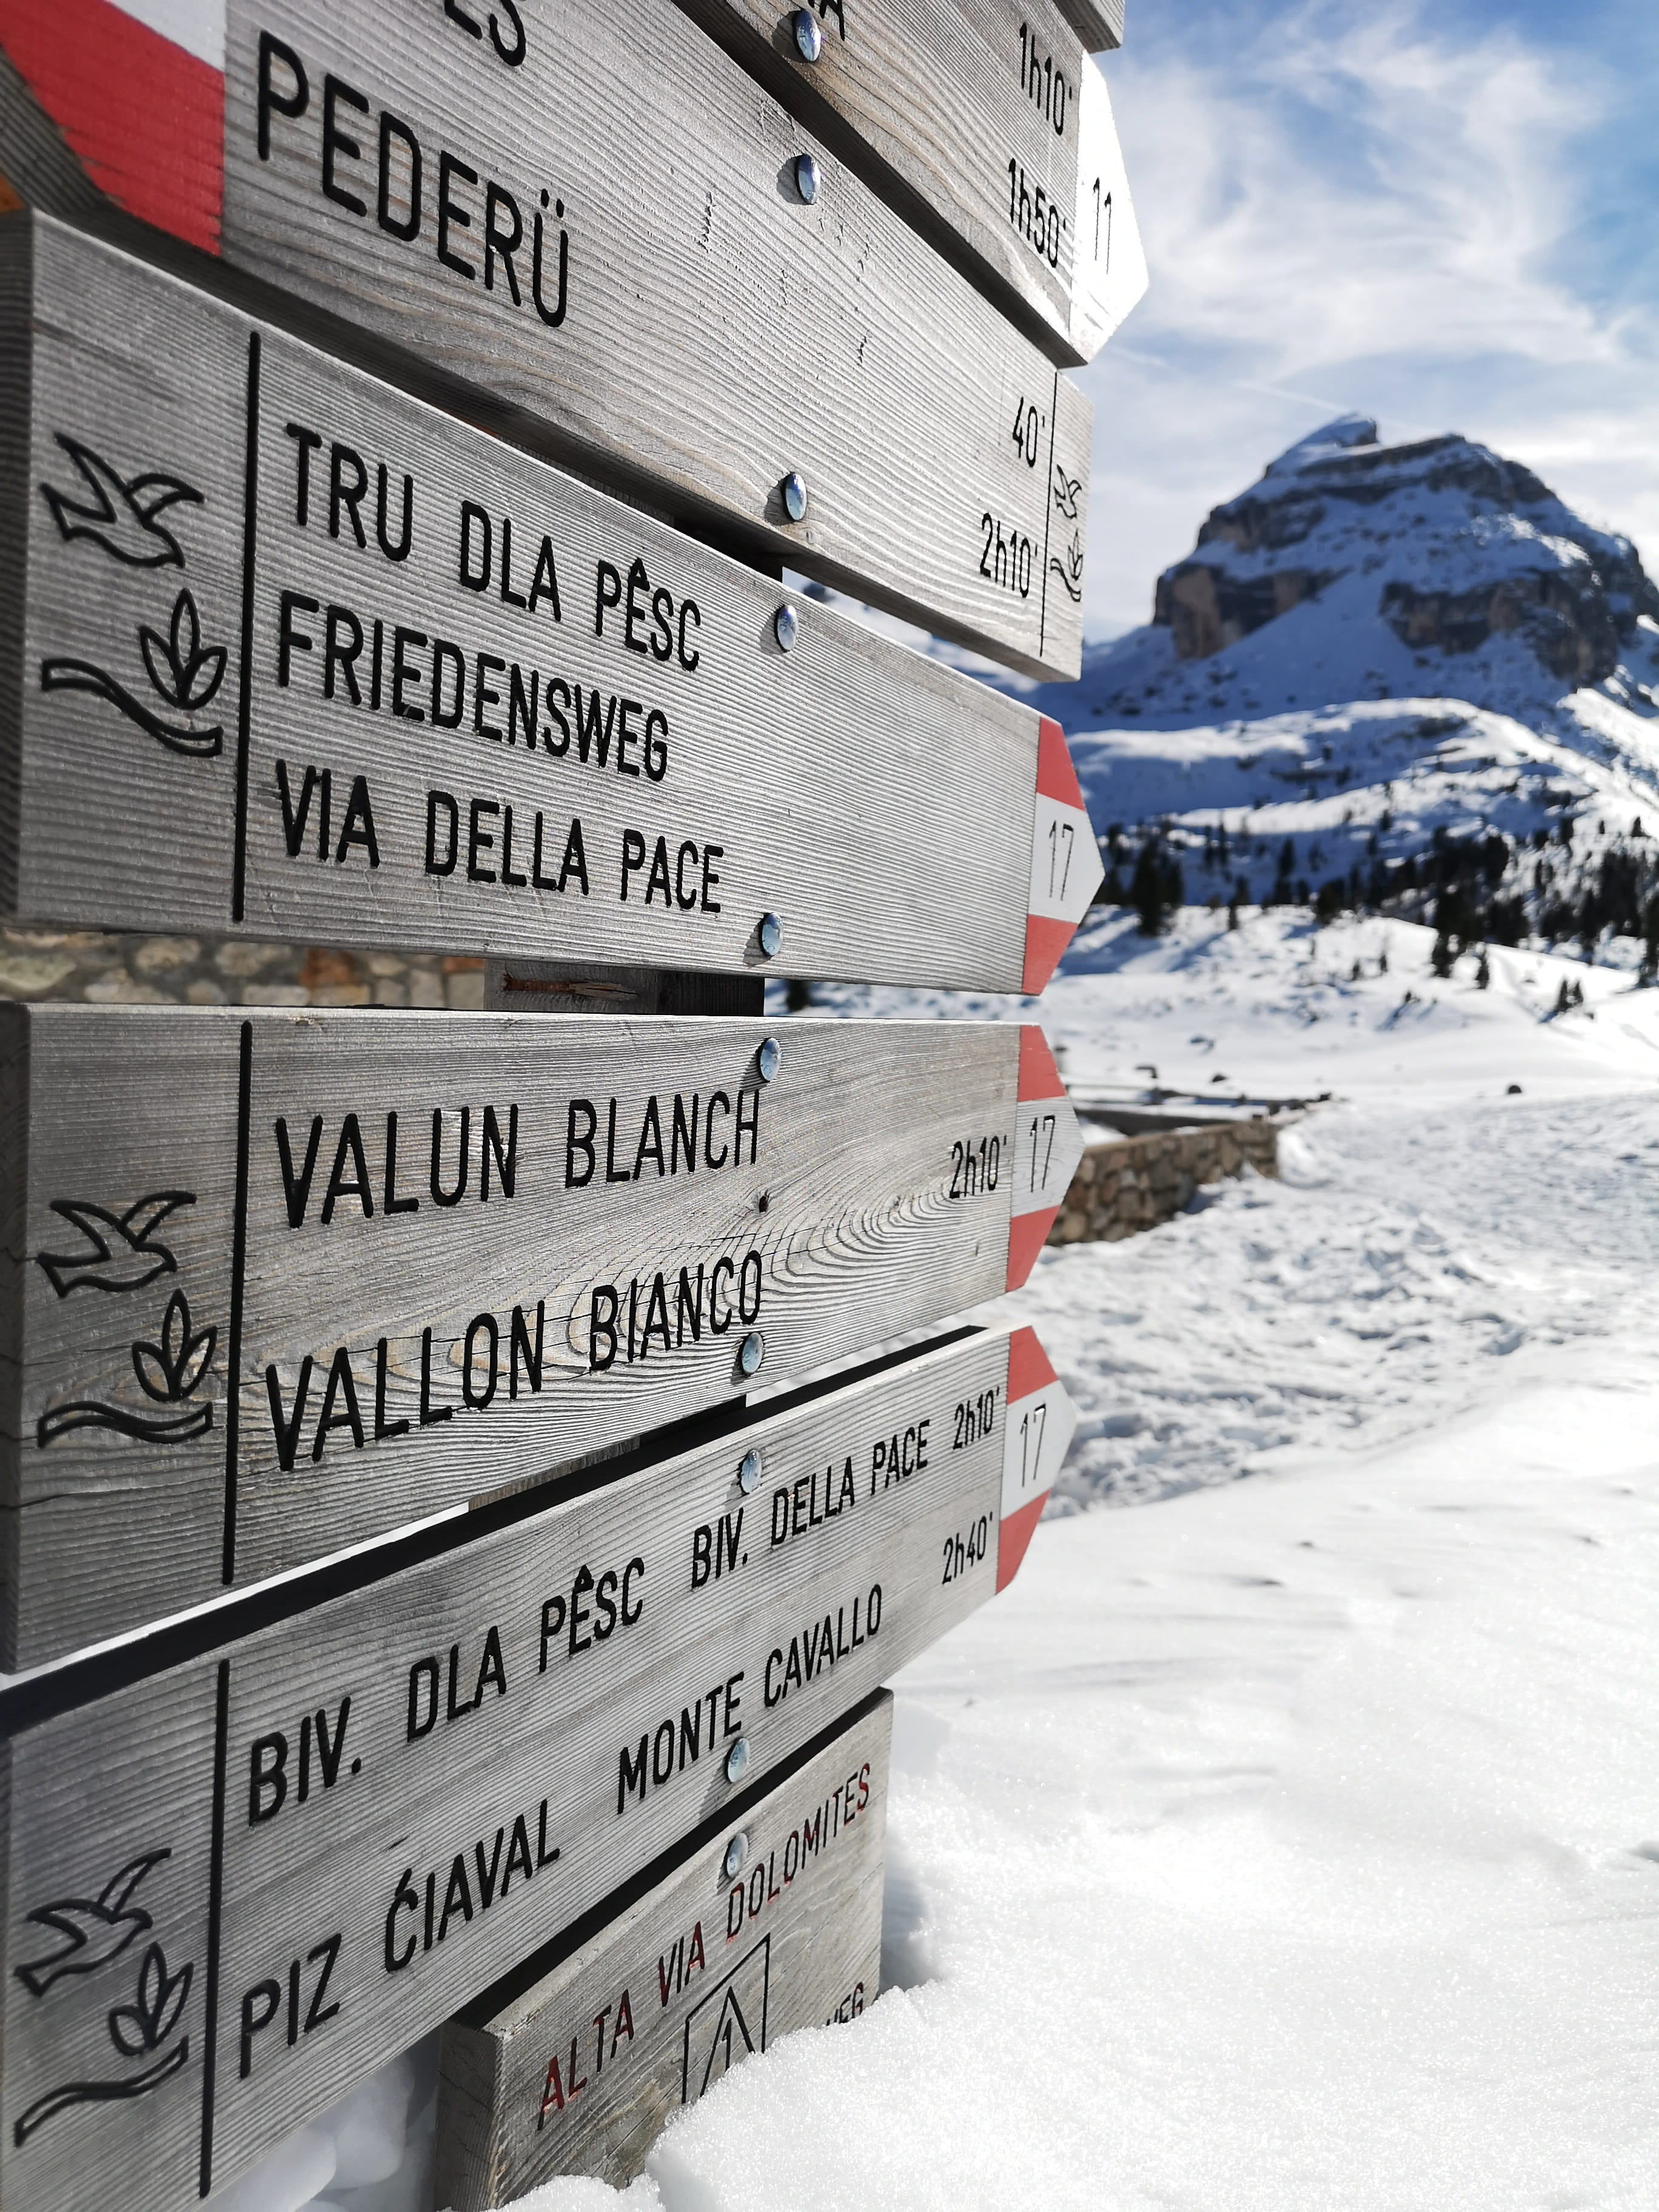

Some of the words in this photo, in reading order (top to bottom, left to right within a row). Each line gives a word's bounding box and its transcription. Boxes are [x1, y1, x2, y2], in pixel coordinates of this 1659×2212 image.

[1019, 22, 1072, 135] 1h10'
[257, 30, 569, 327] PEDERÜ
[1008, 158, 1066, 268] 1h50'
[1093, 177, 1111, 274] 11
[1013, 397, 1045, 467] 40'
[287, 423, 414, 561] TRU
[460, 500, 561, 622] DLA
[596, 557, 701, 671] PÊSC
[980, 512, 1037, 598] 2h10'
[279, 590, 669, 782] FRIEDENSWEG
[276, 759, 381, 868] VIA
[425, 790, 589, 896] DELLA
[620, 828, 725, 913] PACE
[1050, 820, 1073, 901] 17
[276, 1104, 518, 1228] VALUN
[565, 1089, 760, 1188] BLANCH
[949, 1135, 1007, 1199] 2h10'
[1029, 1115, 1056, 1193] 17
[266, 1300, 545, 1471] VALLON
[589, 1250, 762, 1372] BIANCO
[1020, 1403, 1047, 1487] 17
[249, 1697, 361, 1826] BIV.
[407, 1625, 507, 1743] DLA
[540, 1557, 645, 1674] PÊSC
[691, 1507, 748, 1590] BIV.
[771, 1456, 855, 1549] DELLA
[871, 1419, 931, 1495] PACE
[240, 1932, 341, 2080] PIZ
[386, 1798, 560, 1972] ĆIAVAL
[617, 1671, 745, 1815] MONTE
[765, 1583, 882, 1708] CAVALLO
[537, 1989, 634, 2131] ALTA
[659, 1921, 705, 2006] VIA
[726, 1763, 871, 1944] DOLOMITES
